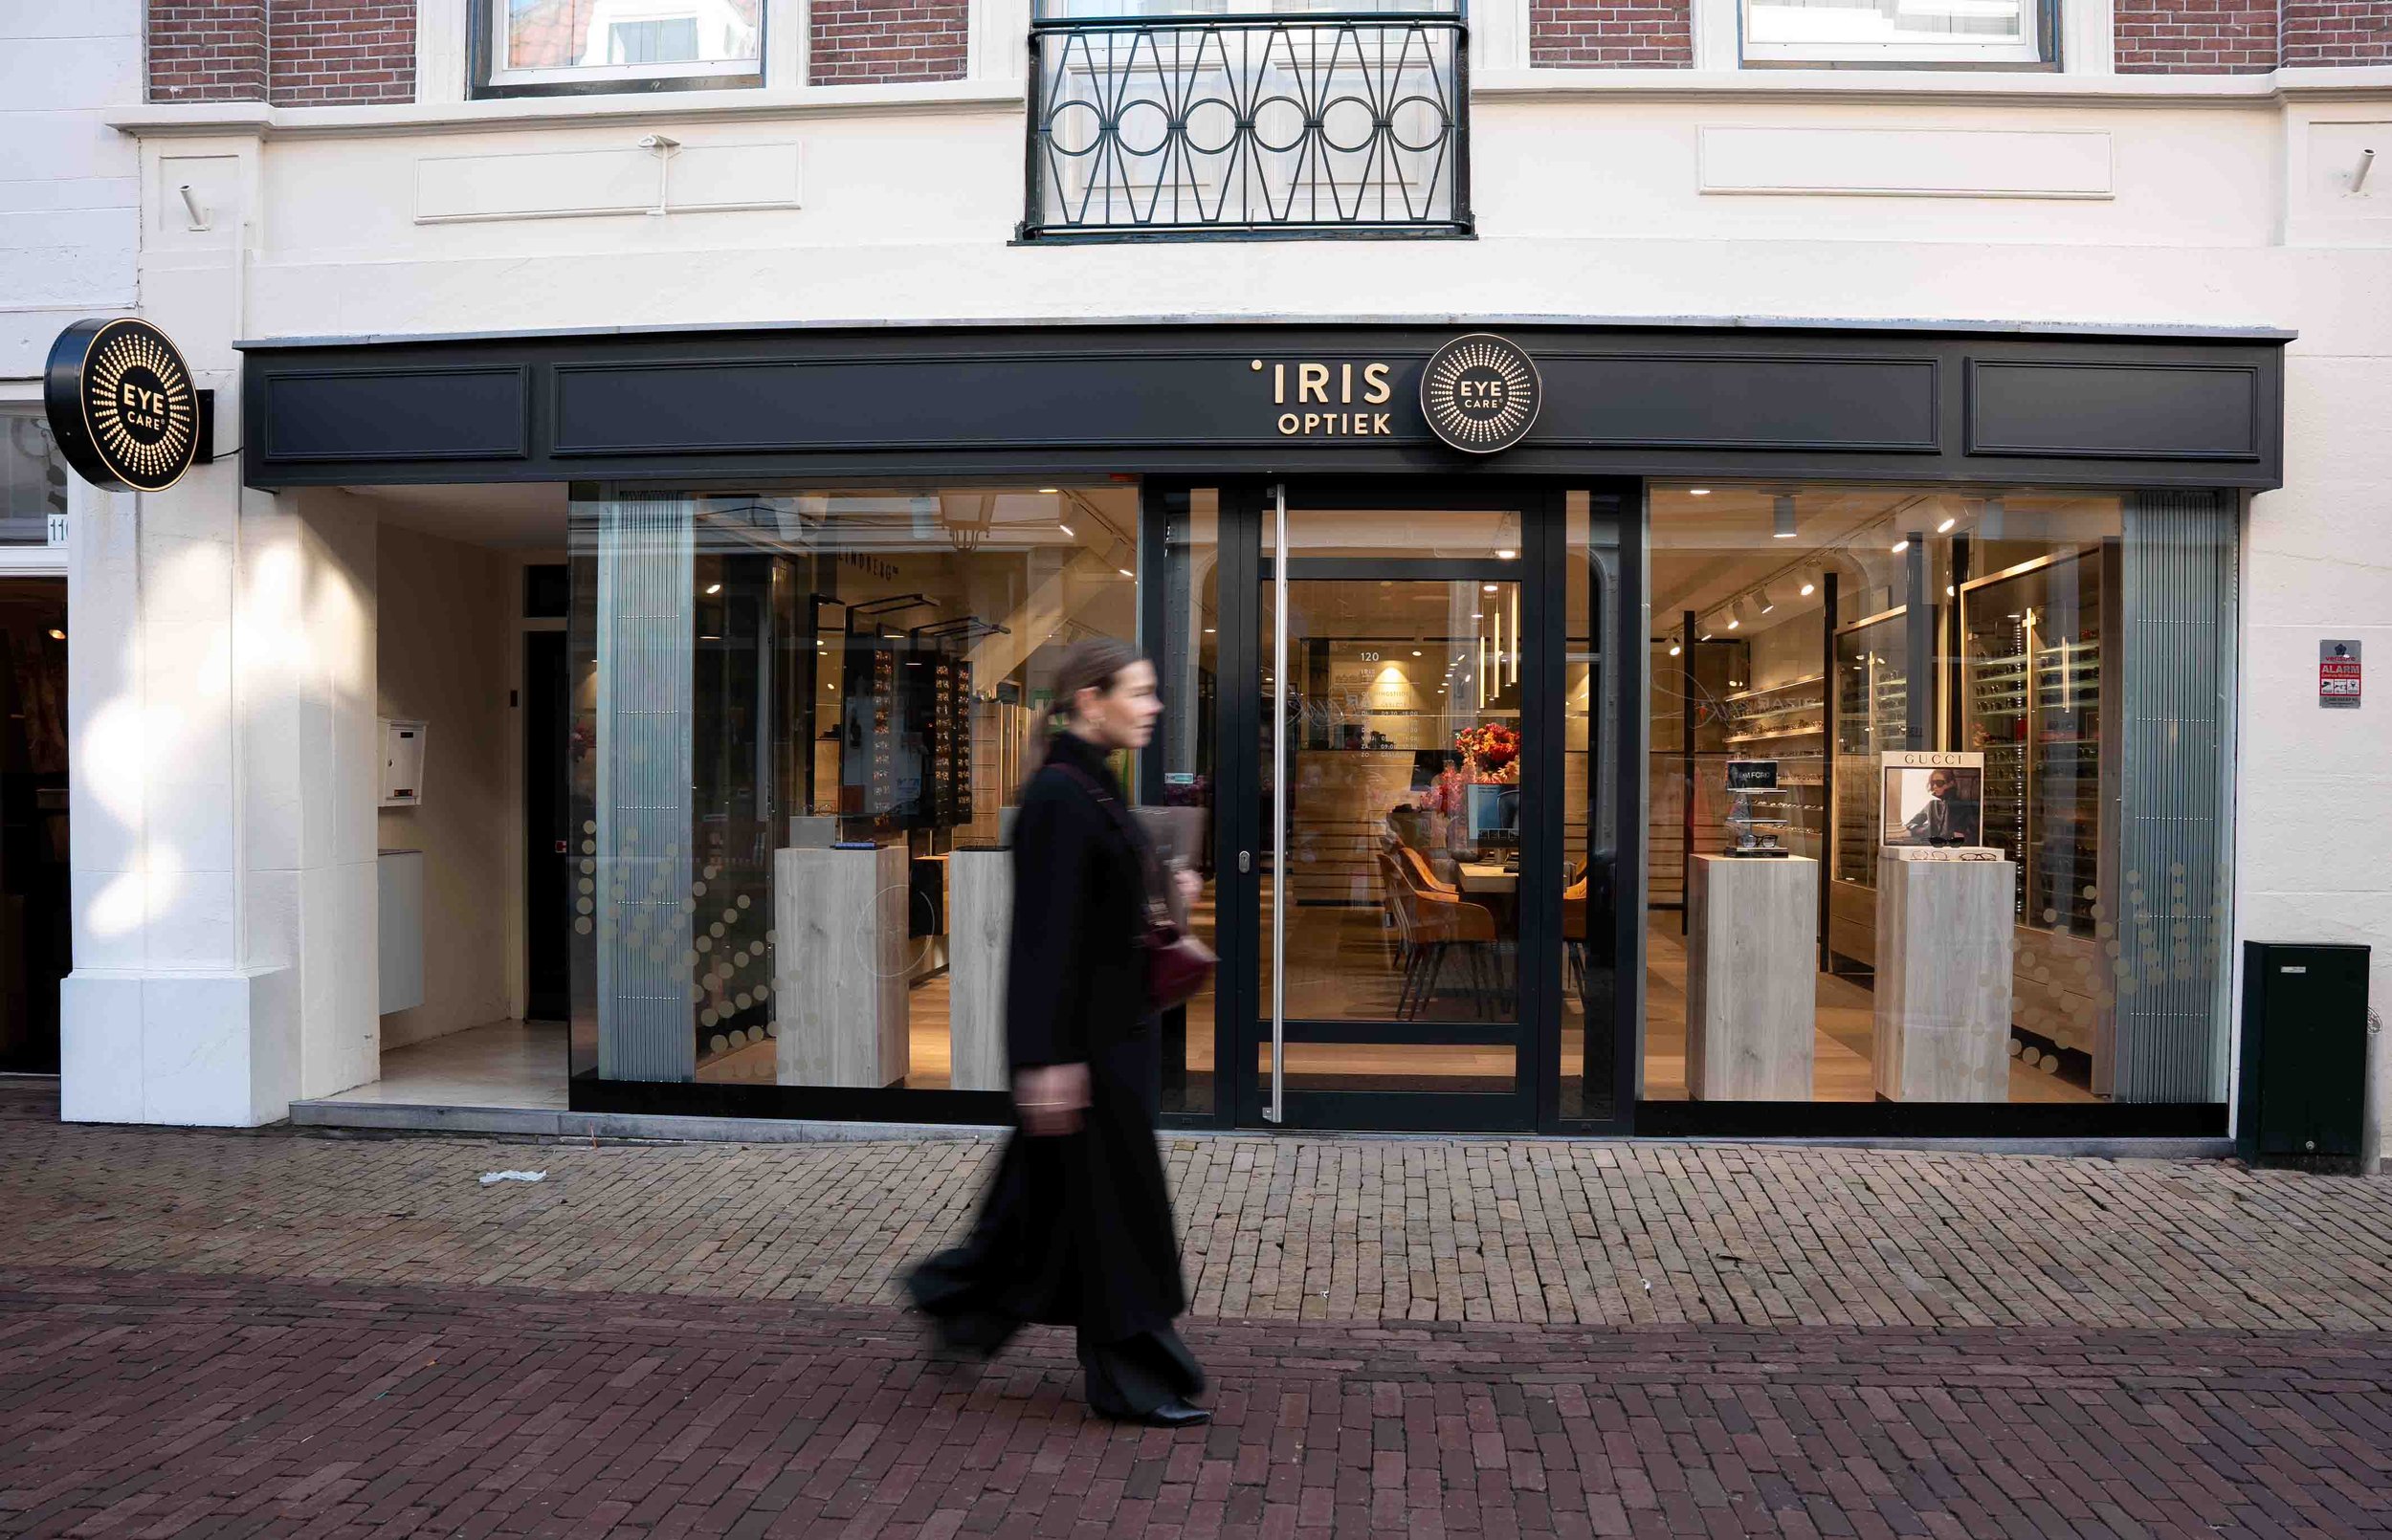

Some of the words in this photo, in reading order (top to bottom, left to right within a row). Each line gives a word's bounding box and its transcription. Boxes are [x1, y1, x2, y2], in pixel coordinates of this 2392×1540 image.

[1274, 363, 1391, 404] IRIS
[1460, 381, 1502, 396] EYE
[123, 383, 165, 415] EYE
[1277, 412, 1391, 434] OPTIEK
[50, 518, 69, 541] 11
[1361, 651, 1380, 662] 120
[2322, 665, 2359, 674] ALARM
[1904, 754, 1962, 765] GUCCI
